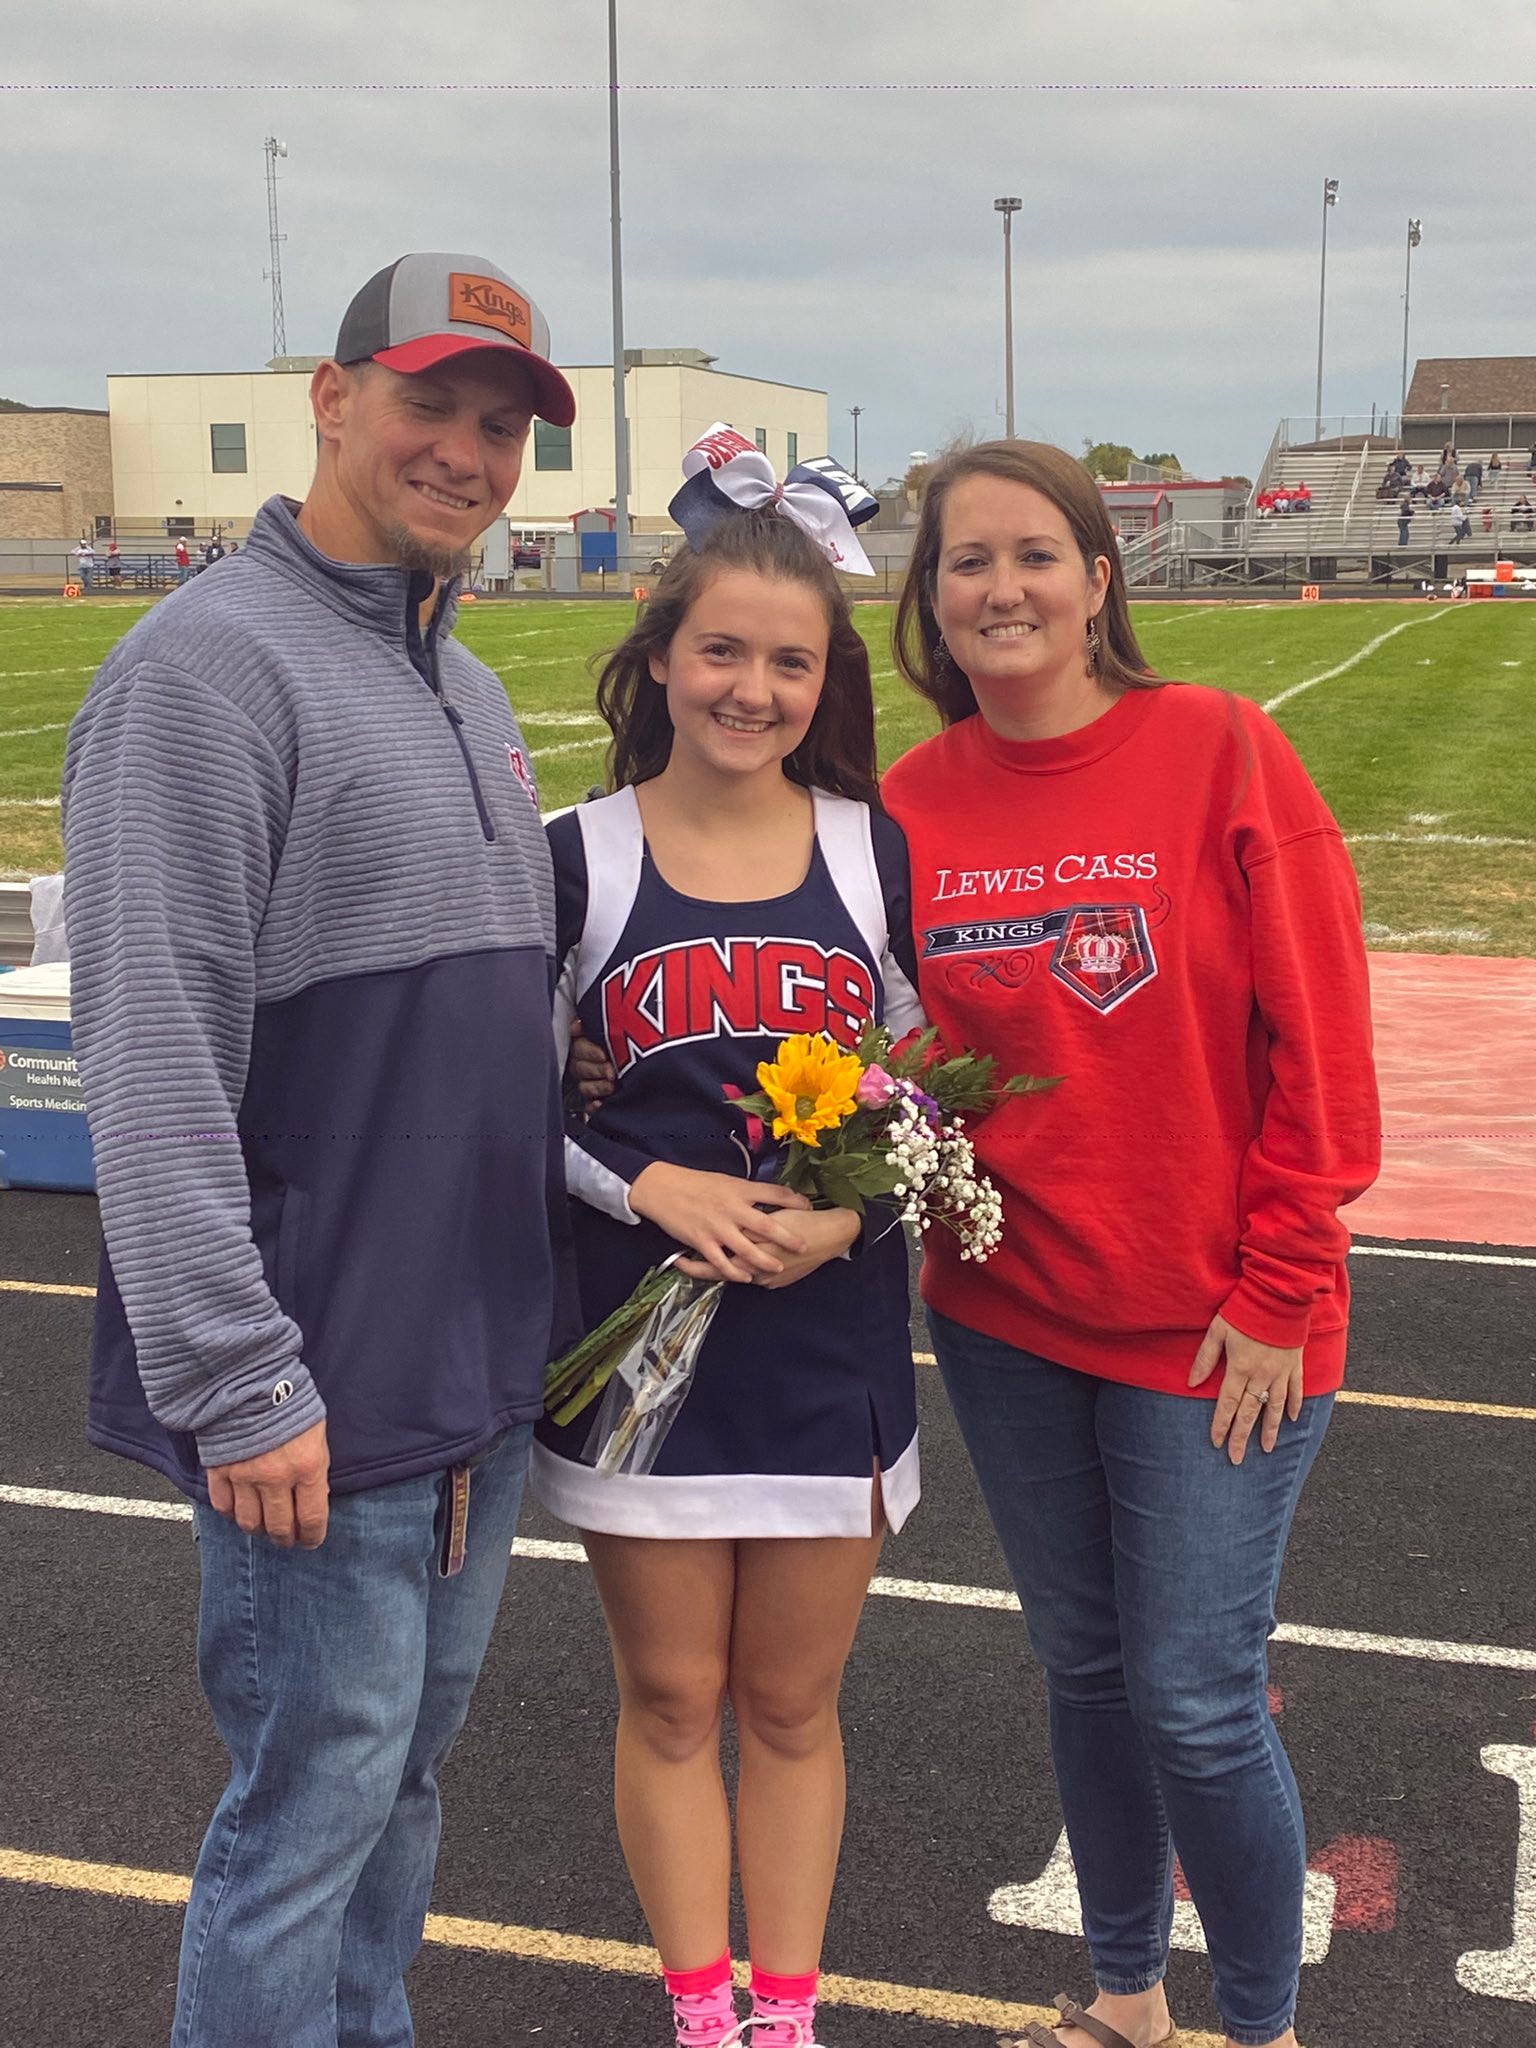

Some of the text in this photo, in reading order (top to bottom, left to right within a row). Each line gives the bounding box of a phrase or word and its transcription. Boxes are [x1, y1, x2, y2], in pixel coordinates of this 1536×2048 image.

[459, 283, 526, 326] Kings
[1304, 586, 1317, 599] 40
[931, 852, 1158, 901] LEWIS CASS
[955, 922, 1045, 944] KINGS
[601, 936, 876, 1079] KINGS
[26, 1073, 61, 1086] Health
[9, 1095, 44, 1109] Sports
